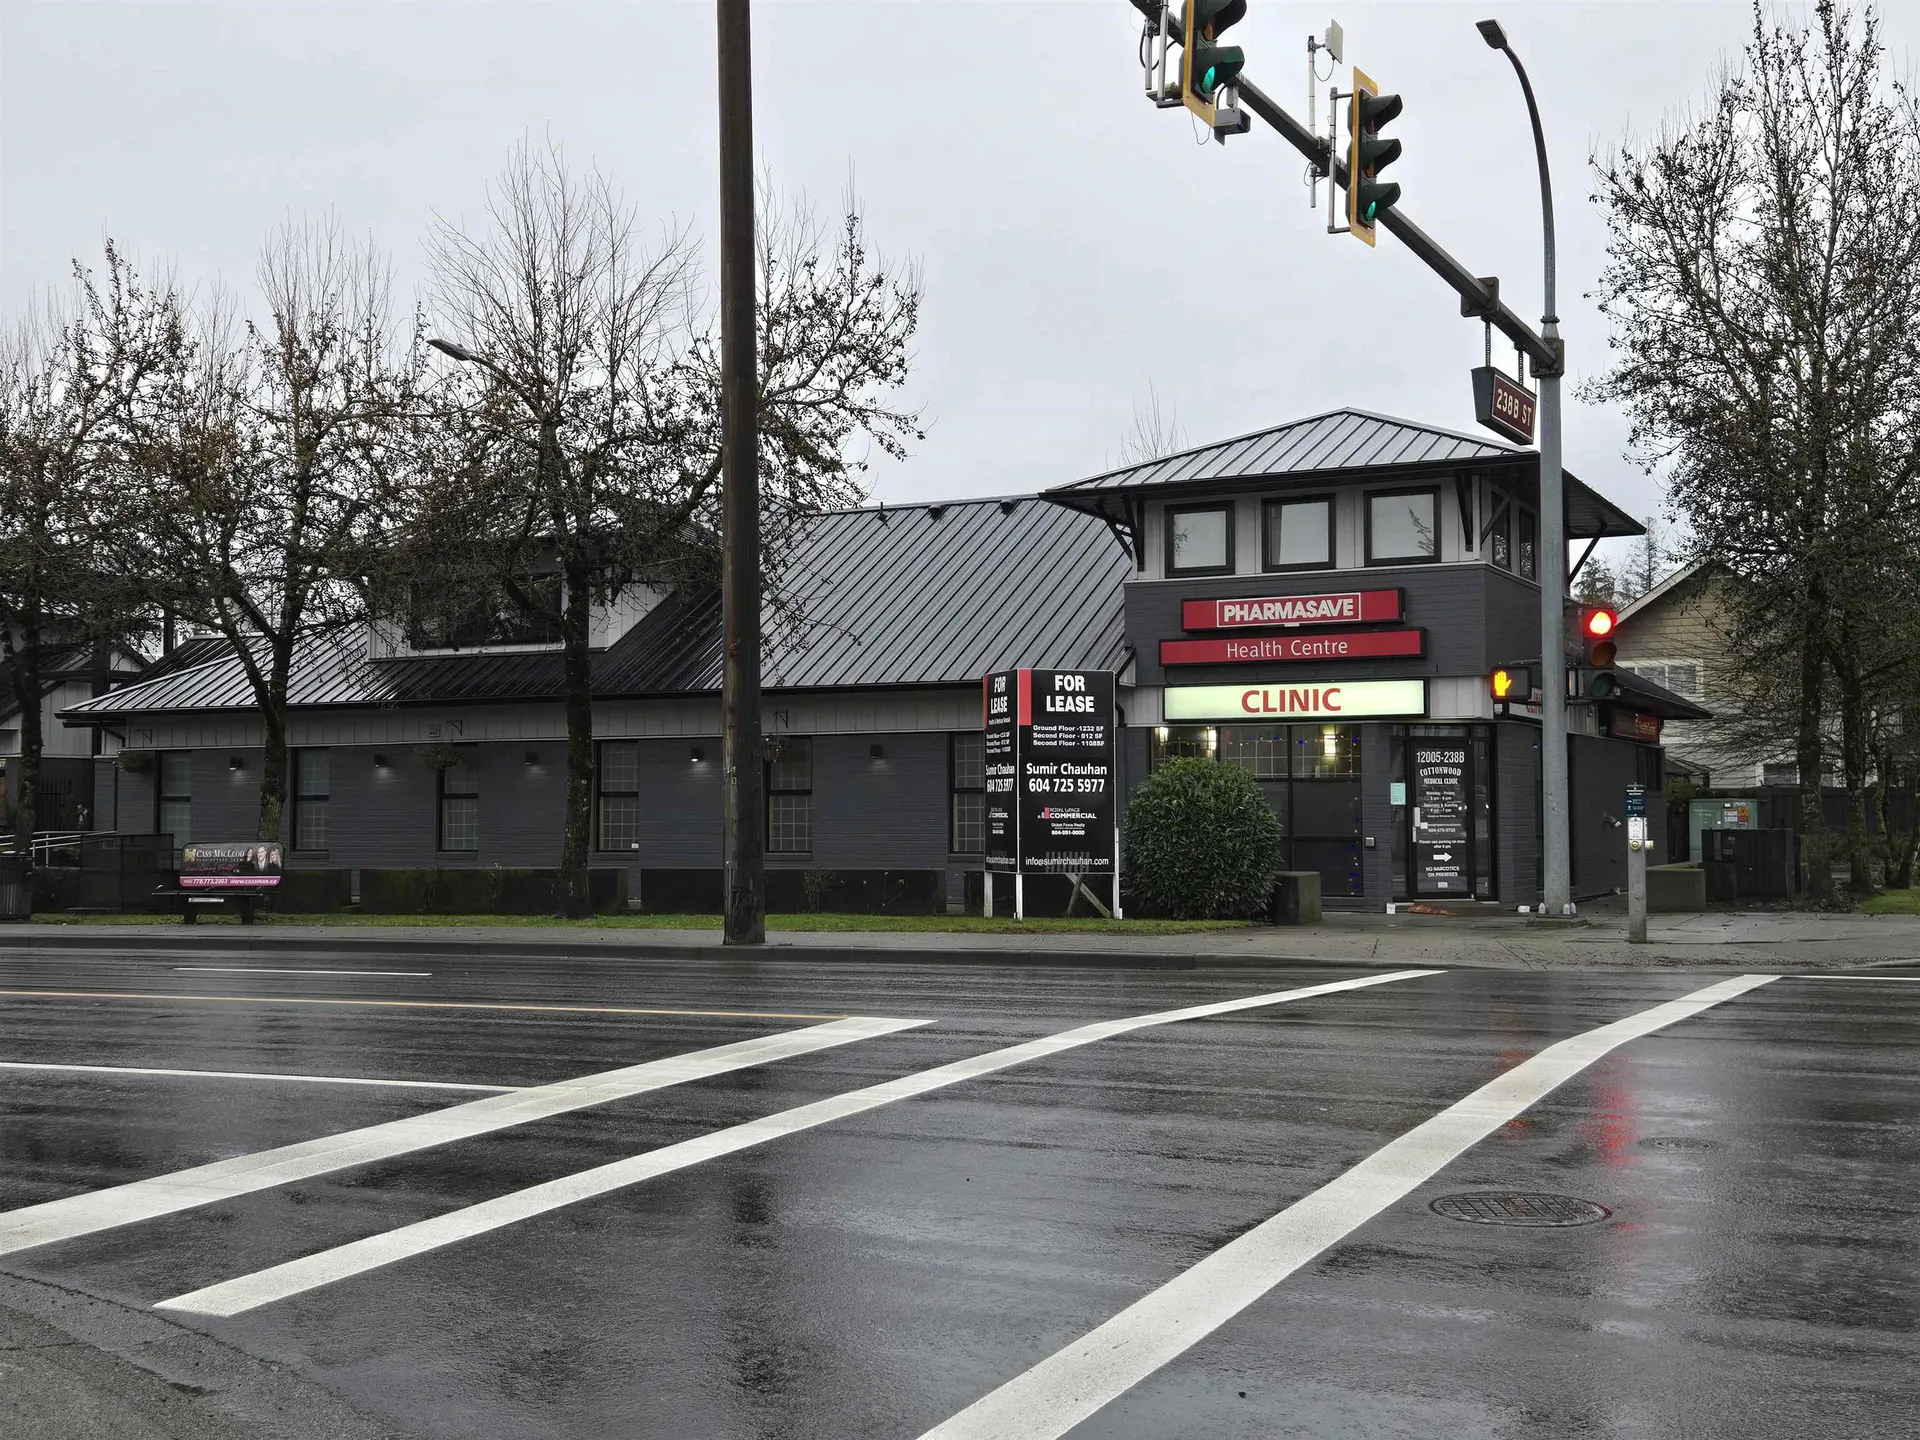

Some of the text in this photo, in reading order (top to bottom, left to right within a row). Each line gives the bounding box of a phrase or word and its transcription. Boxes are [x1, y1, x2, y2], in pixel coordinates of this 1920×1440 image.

[1496, 388, 1532, 426] 238B ST
[1223, 598, 1354, 622] PHARMASAVE
[1226, 640, 1348, 658] Health Centre
[994, 676, 1006, 693] FOR
[1054, 674, 1085, 692] FOR
[990, 696, 1008, 714] LEASE
[1046, 695, 1095, 712] LEASE
[1241, 688, 1341, 713] CLINIC
[1416, 751, 1465, 763] 12005-238B
[1026, 762, 1107, 775] Sumir Chauhan
[1420, 766, 1462, 777] COTTONWOOD
[1029, 778, 1105, 792] 604 725 5977
[1025, 856, 1109, 867] info@sumirchauhan.com
